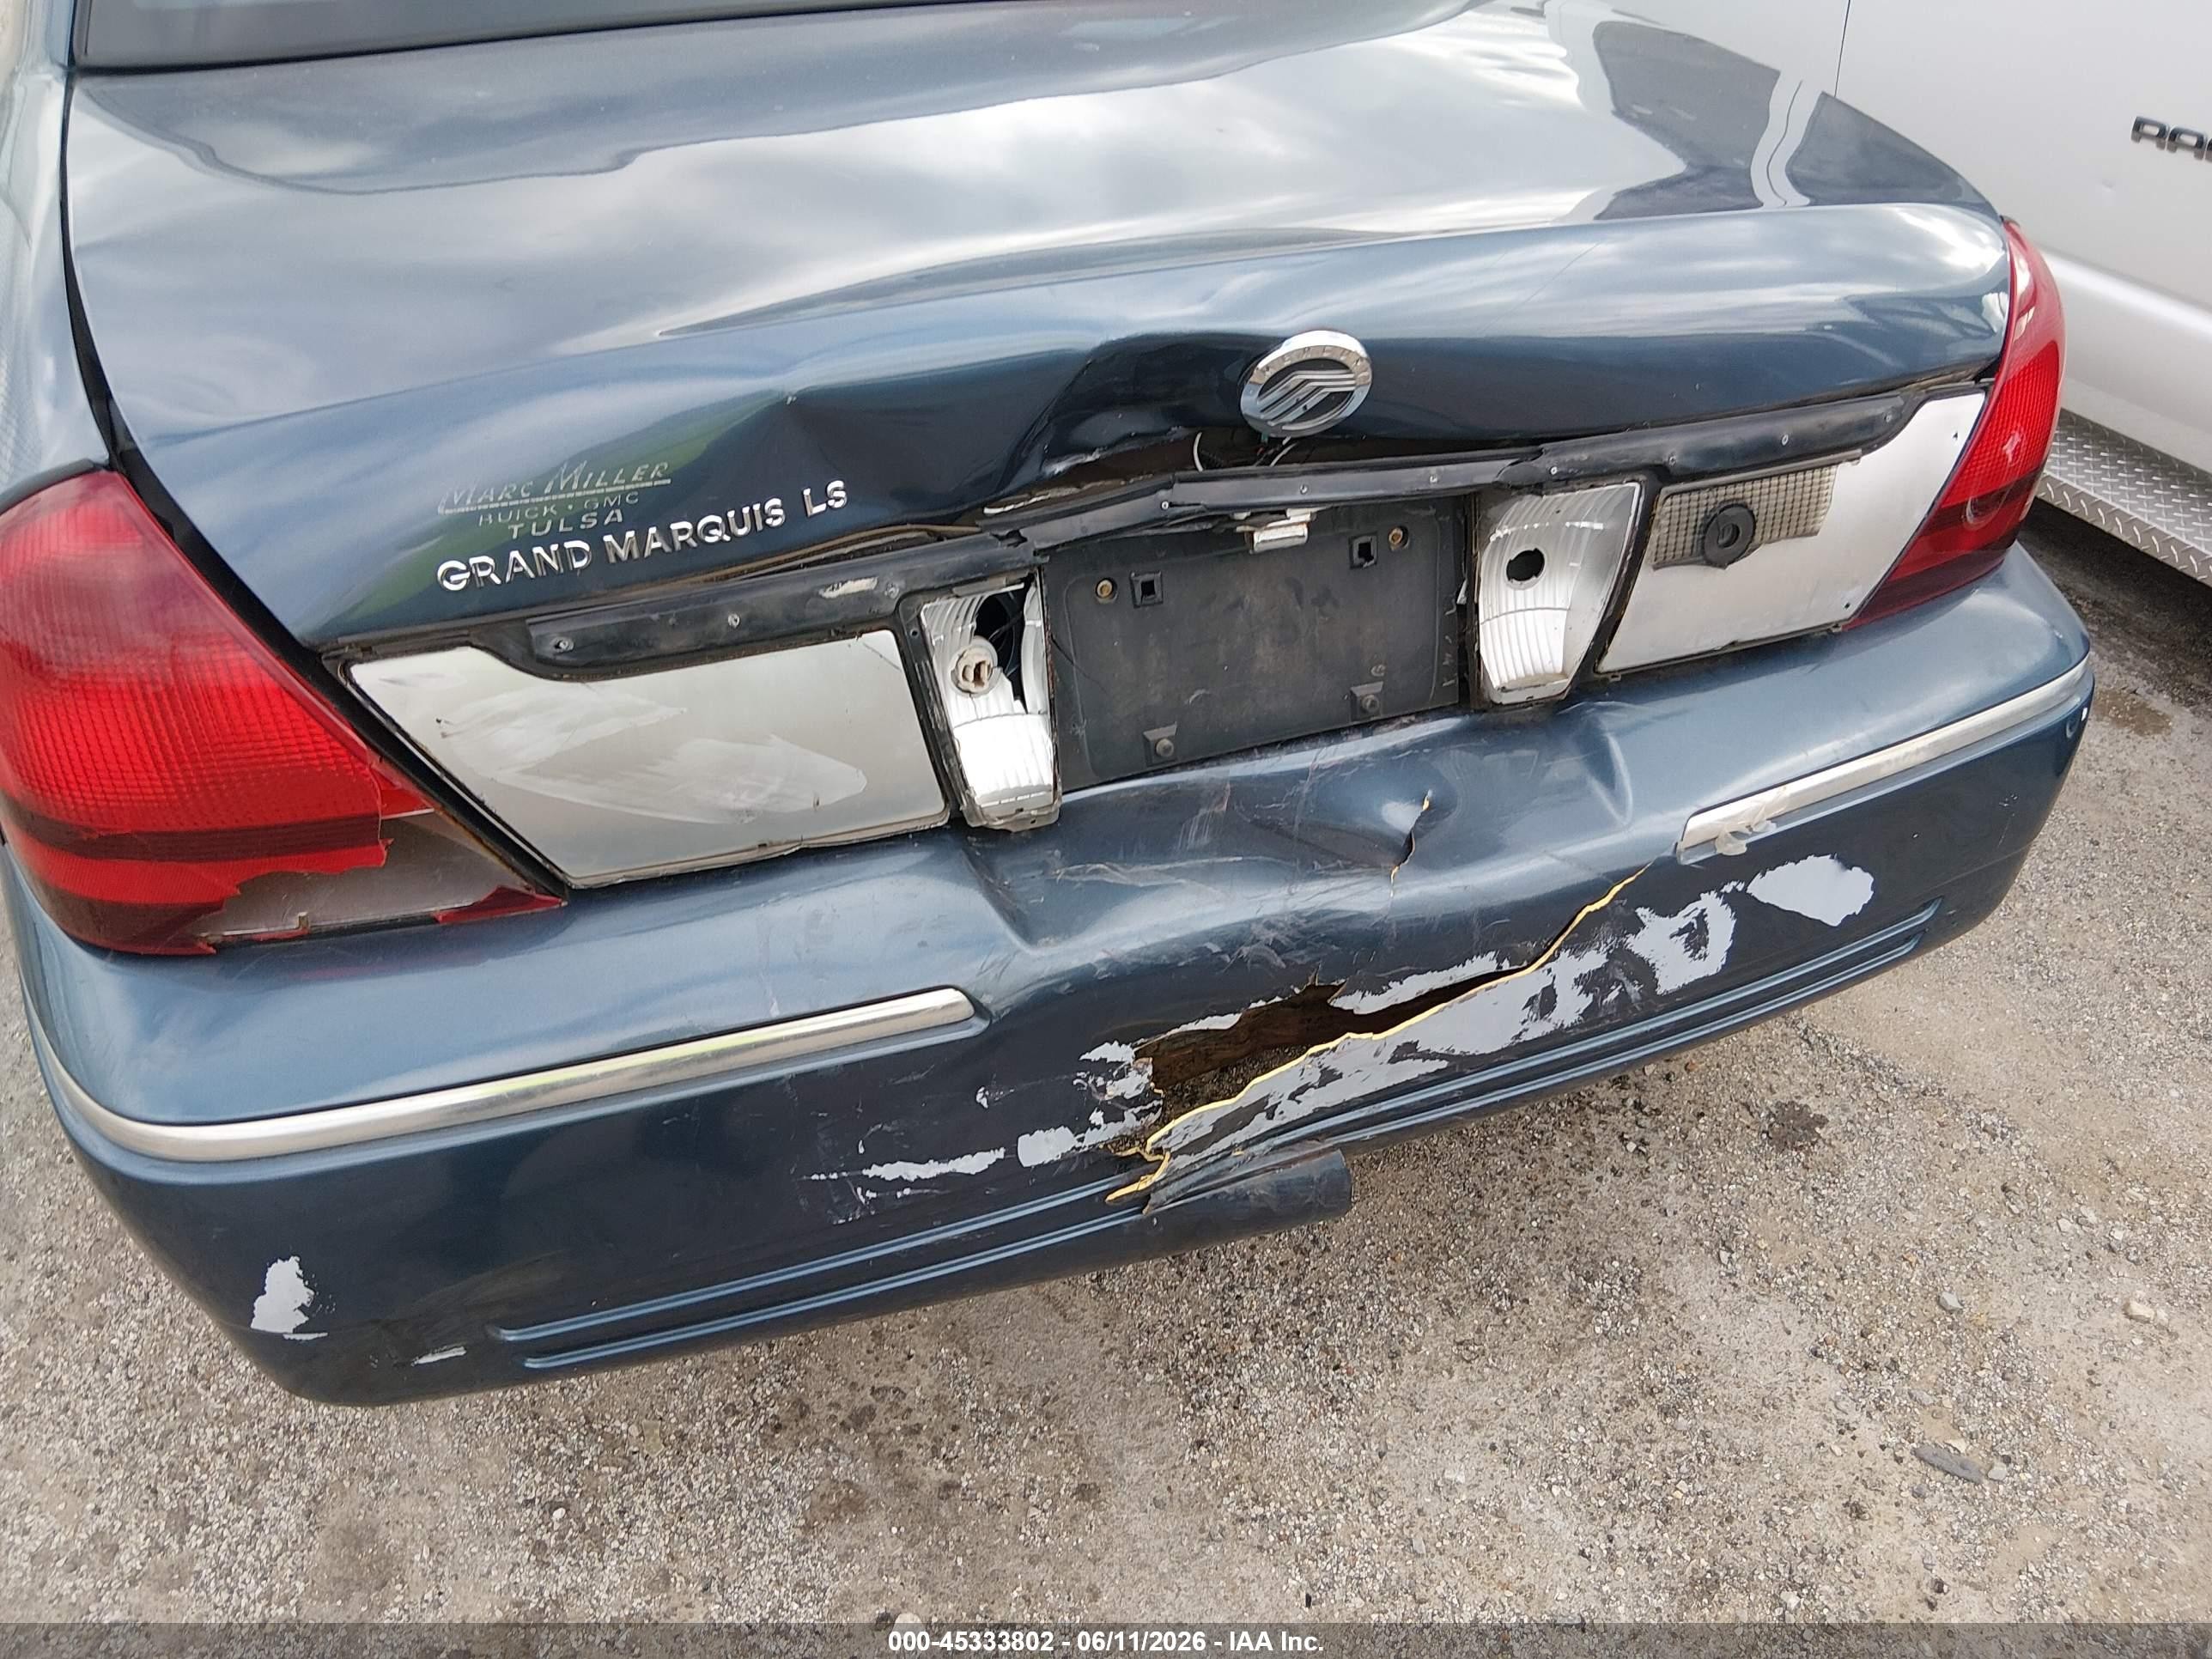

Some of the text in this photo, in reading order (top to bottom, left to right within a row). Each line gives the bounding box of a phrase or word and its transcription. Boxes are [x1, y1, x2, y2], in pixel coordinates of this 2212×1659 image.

[2130, 116, 2212, 162] RA
[544, 459, 669, 494] MILLER
[478, 490, 639, 527] BUICK GMC
[507, 508, 623, 540] TULSA
[436, 479, 848, 592] GRAND MARQUIS LS
